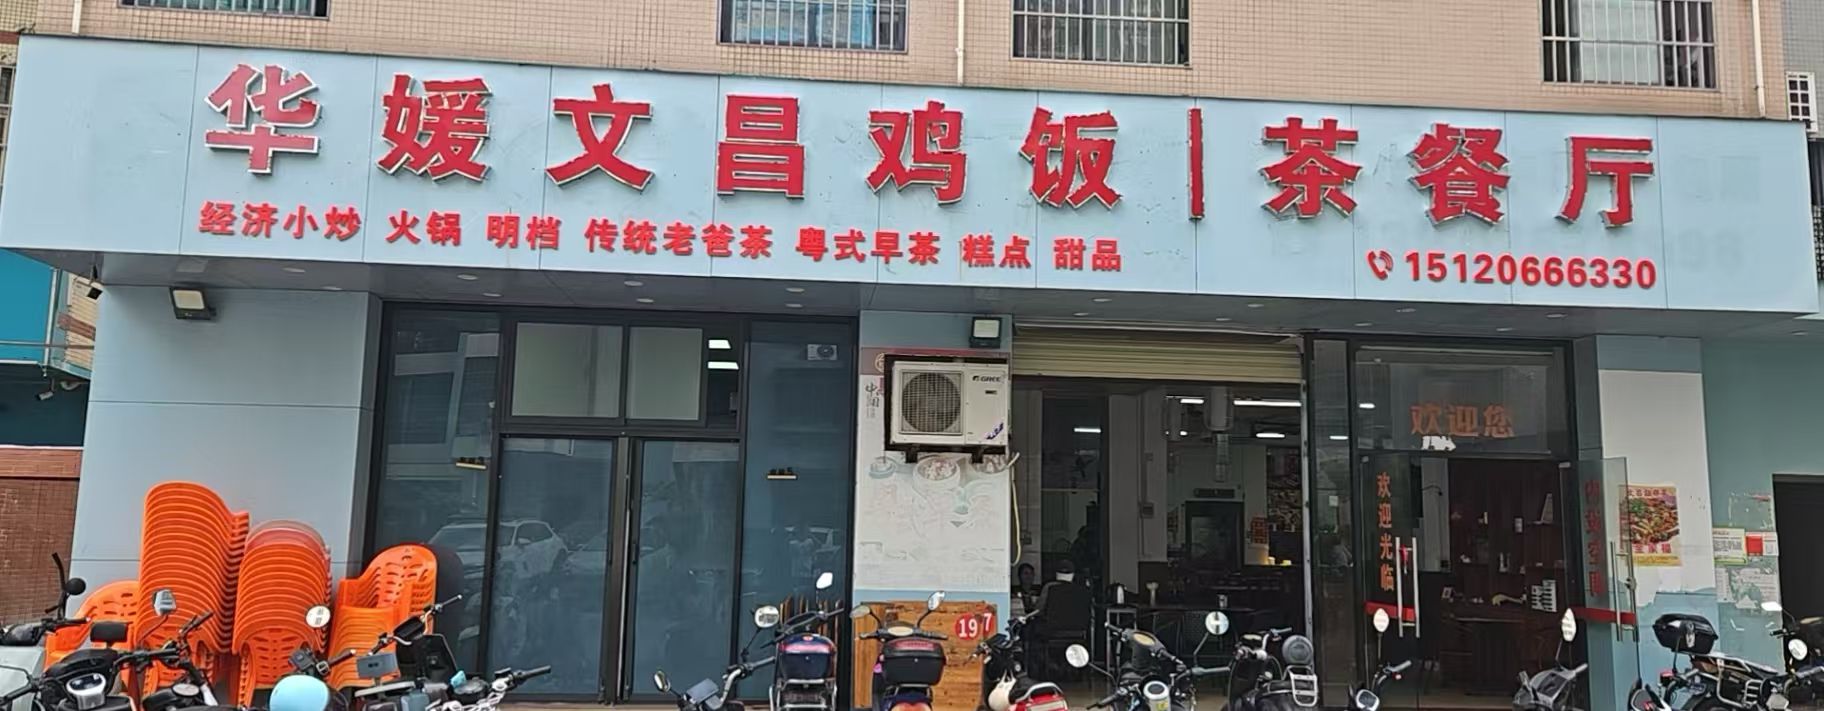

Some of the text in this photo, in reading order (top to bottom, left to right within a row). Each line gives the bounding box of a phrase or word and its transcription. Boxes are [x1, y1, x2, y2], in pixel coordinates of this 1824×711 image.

[1261, 116, 1653, 228] 茶餐厅
[199, 201, 1122, 271] 经济小炒 火锅 明档 传统老爸茶 粤式早茶 糕点 甜品
[1405, 249, 1657, 289] 15120666330
[1409, 402, 1515, 438] 欢迎您
[1376, 471, 1395, 592] 欢迎光临
